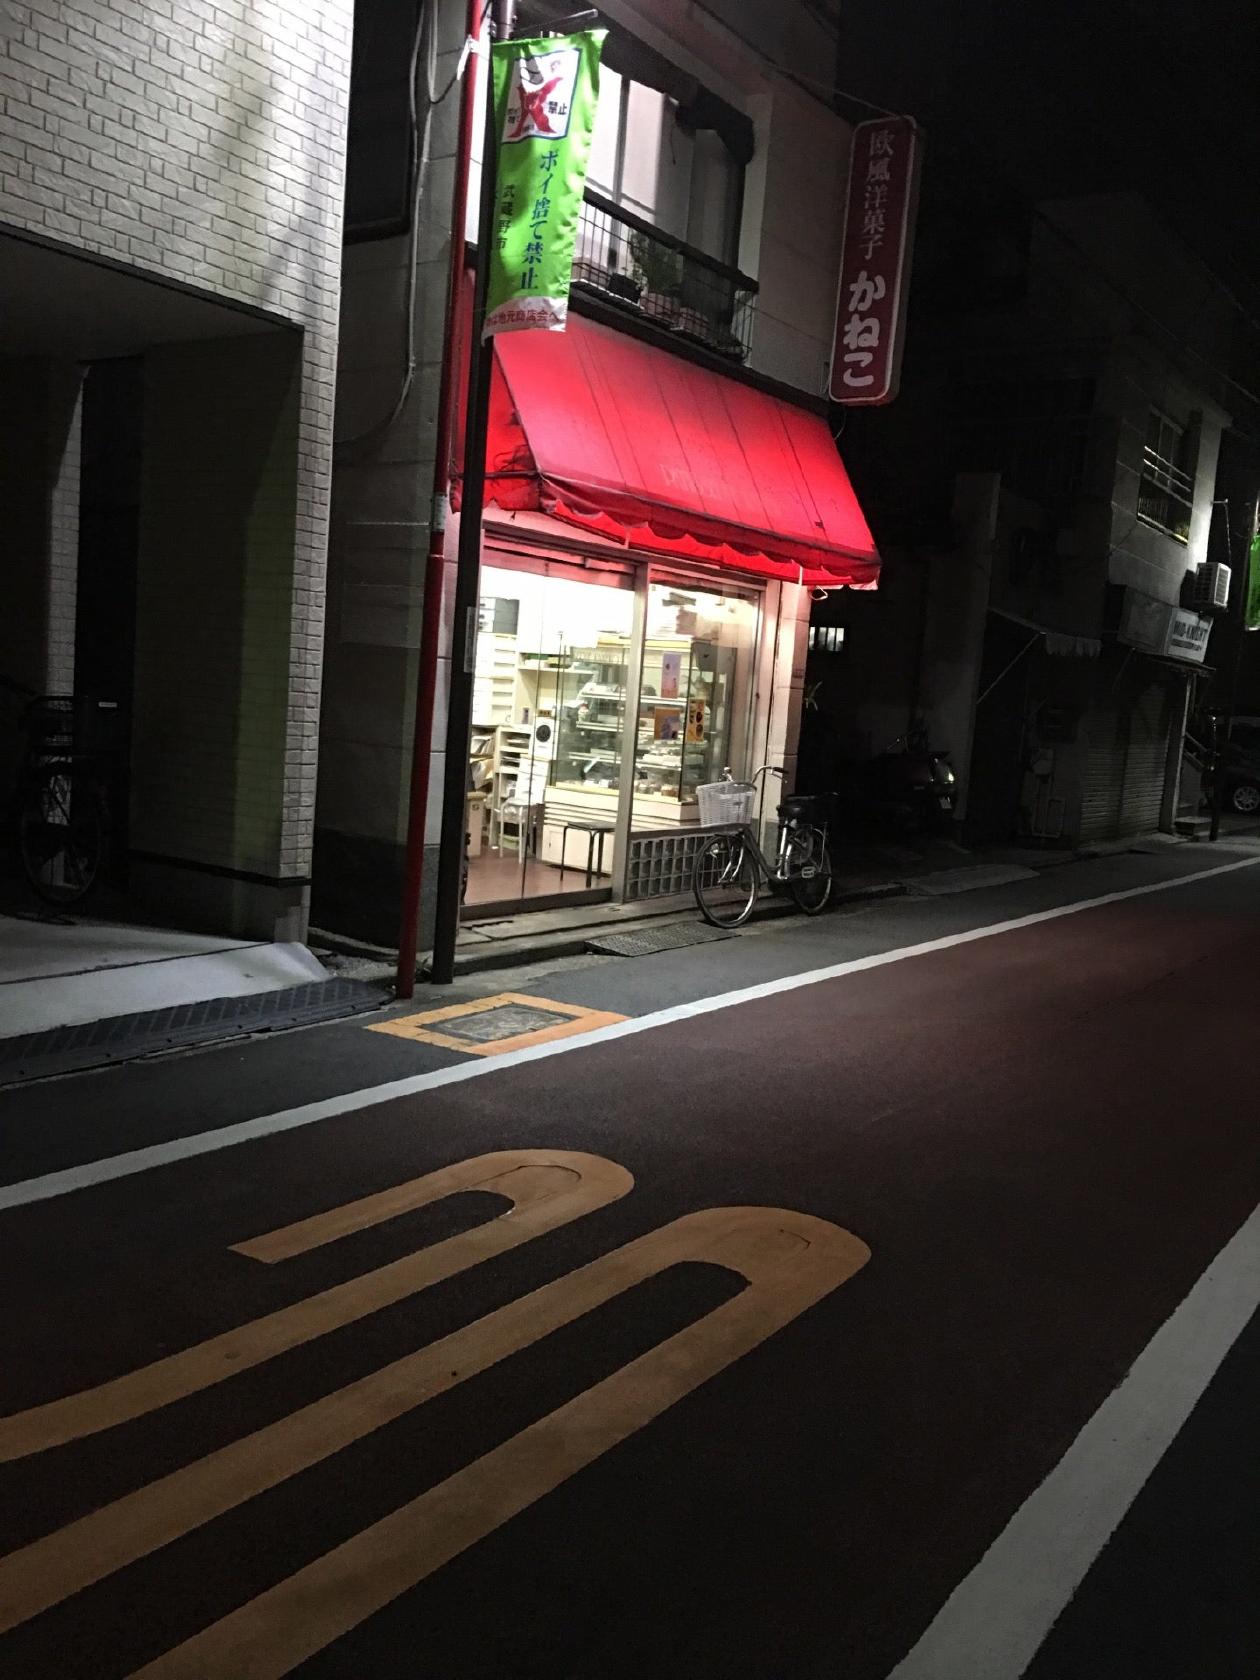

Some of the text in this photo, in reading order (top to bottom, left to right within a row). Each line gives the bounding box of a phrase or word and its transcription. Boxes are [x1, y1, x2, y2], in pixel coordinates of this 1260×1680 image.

[519, 148, 559, 290] ポイ捨て禁止
[843, 129, 894, 387] 欧風洋菓子 かねこ
